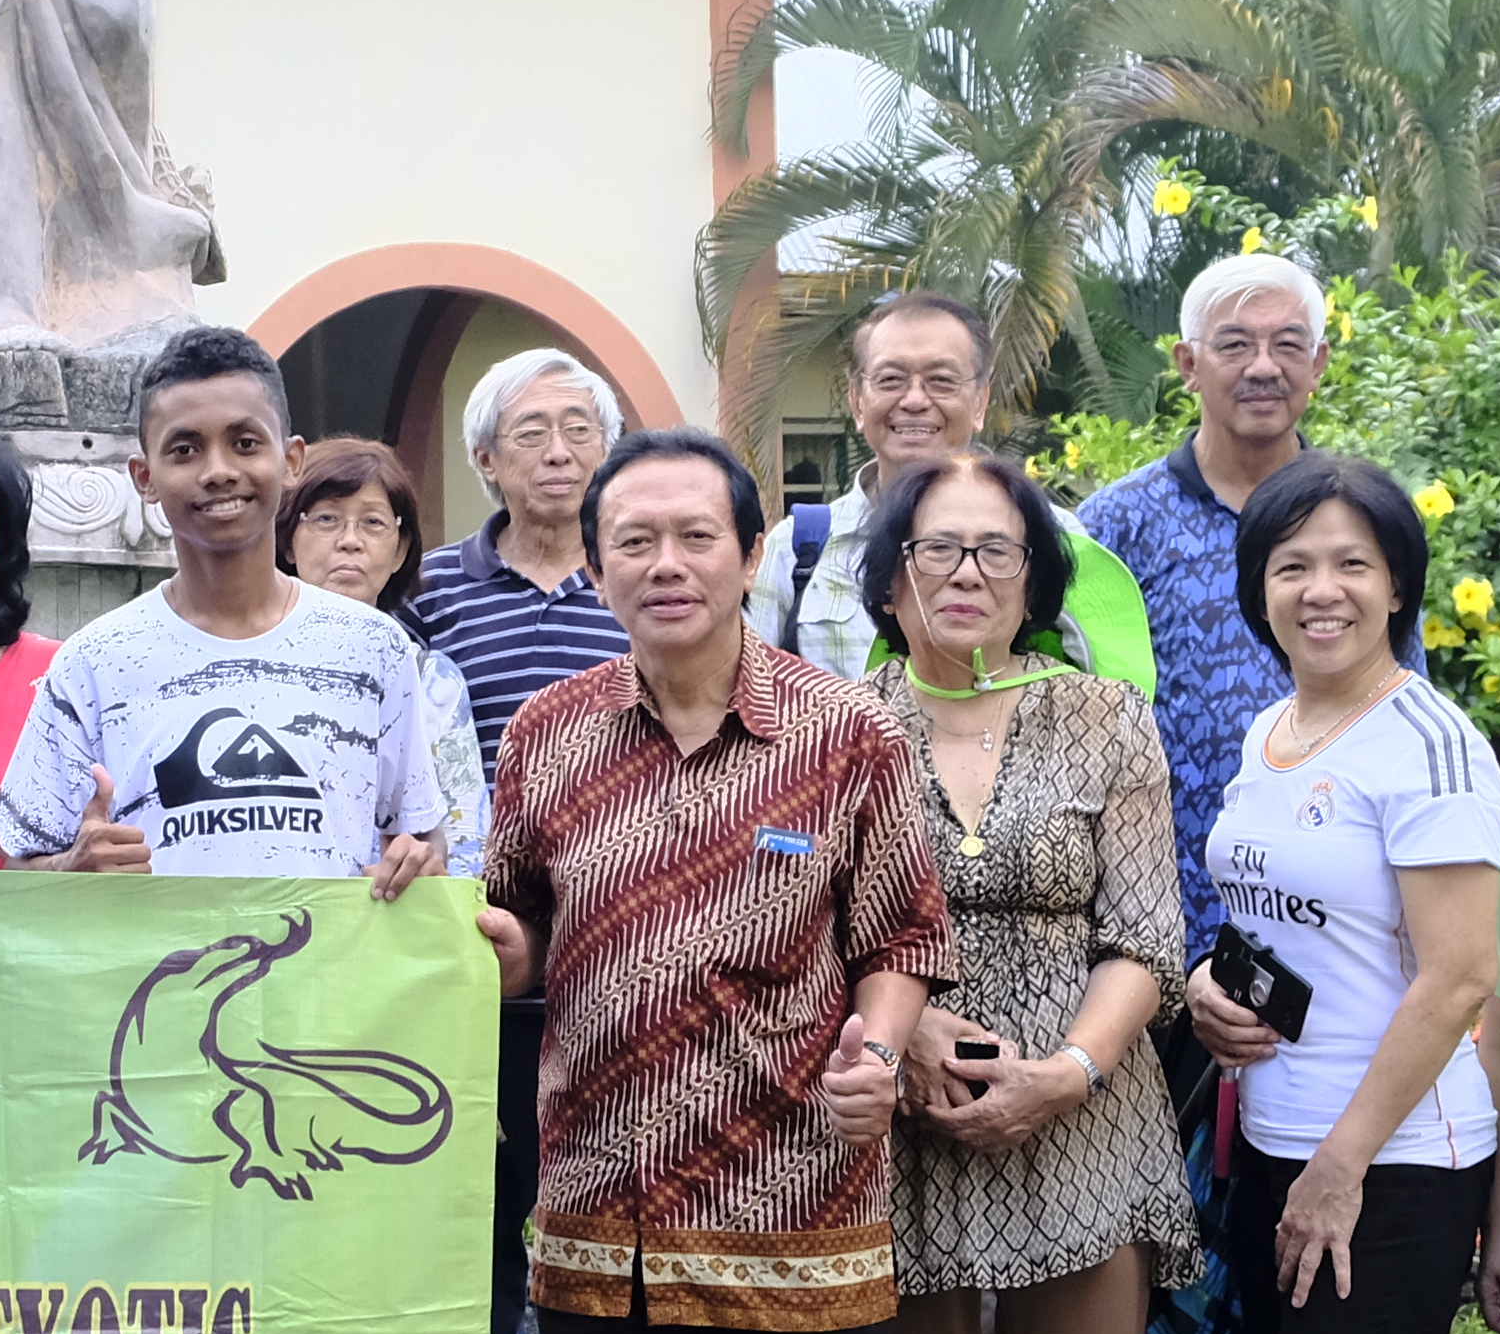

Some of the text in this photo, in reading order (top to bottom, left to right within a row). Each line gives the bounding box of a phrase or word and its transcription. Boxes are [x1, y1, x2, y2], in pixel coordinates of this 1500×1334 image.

[162, 805, 324, 843] QUIKSILVER
[1231, 844, 1266, 880] Fly
[1217, 873, 1327, 928] mirates
